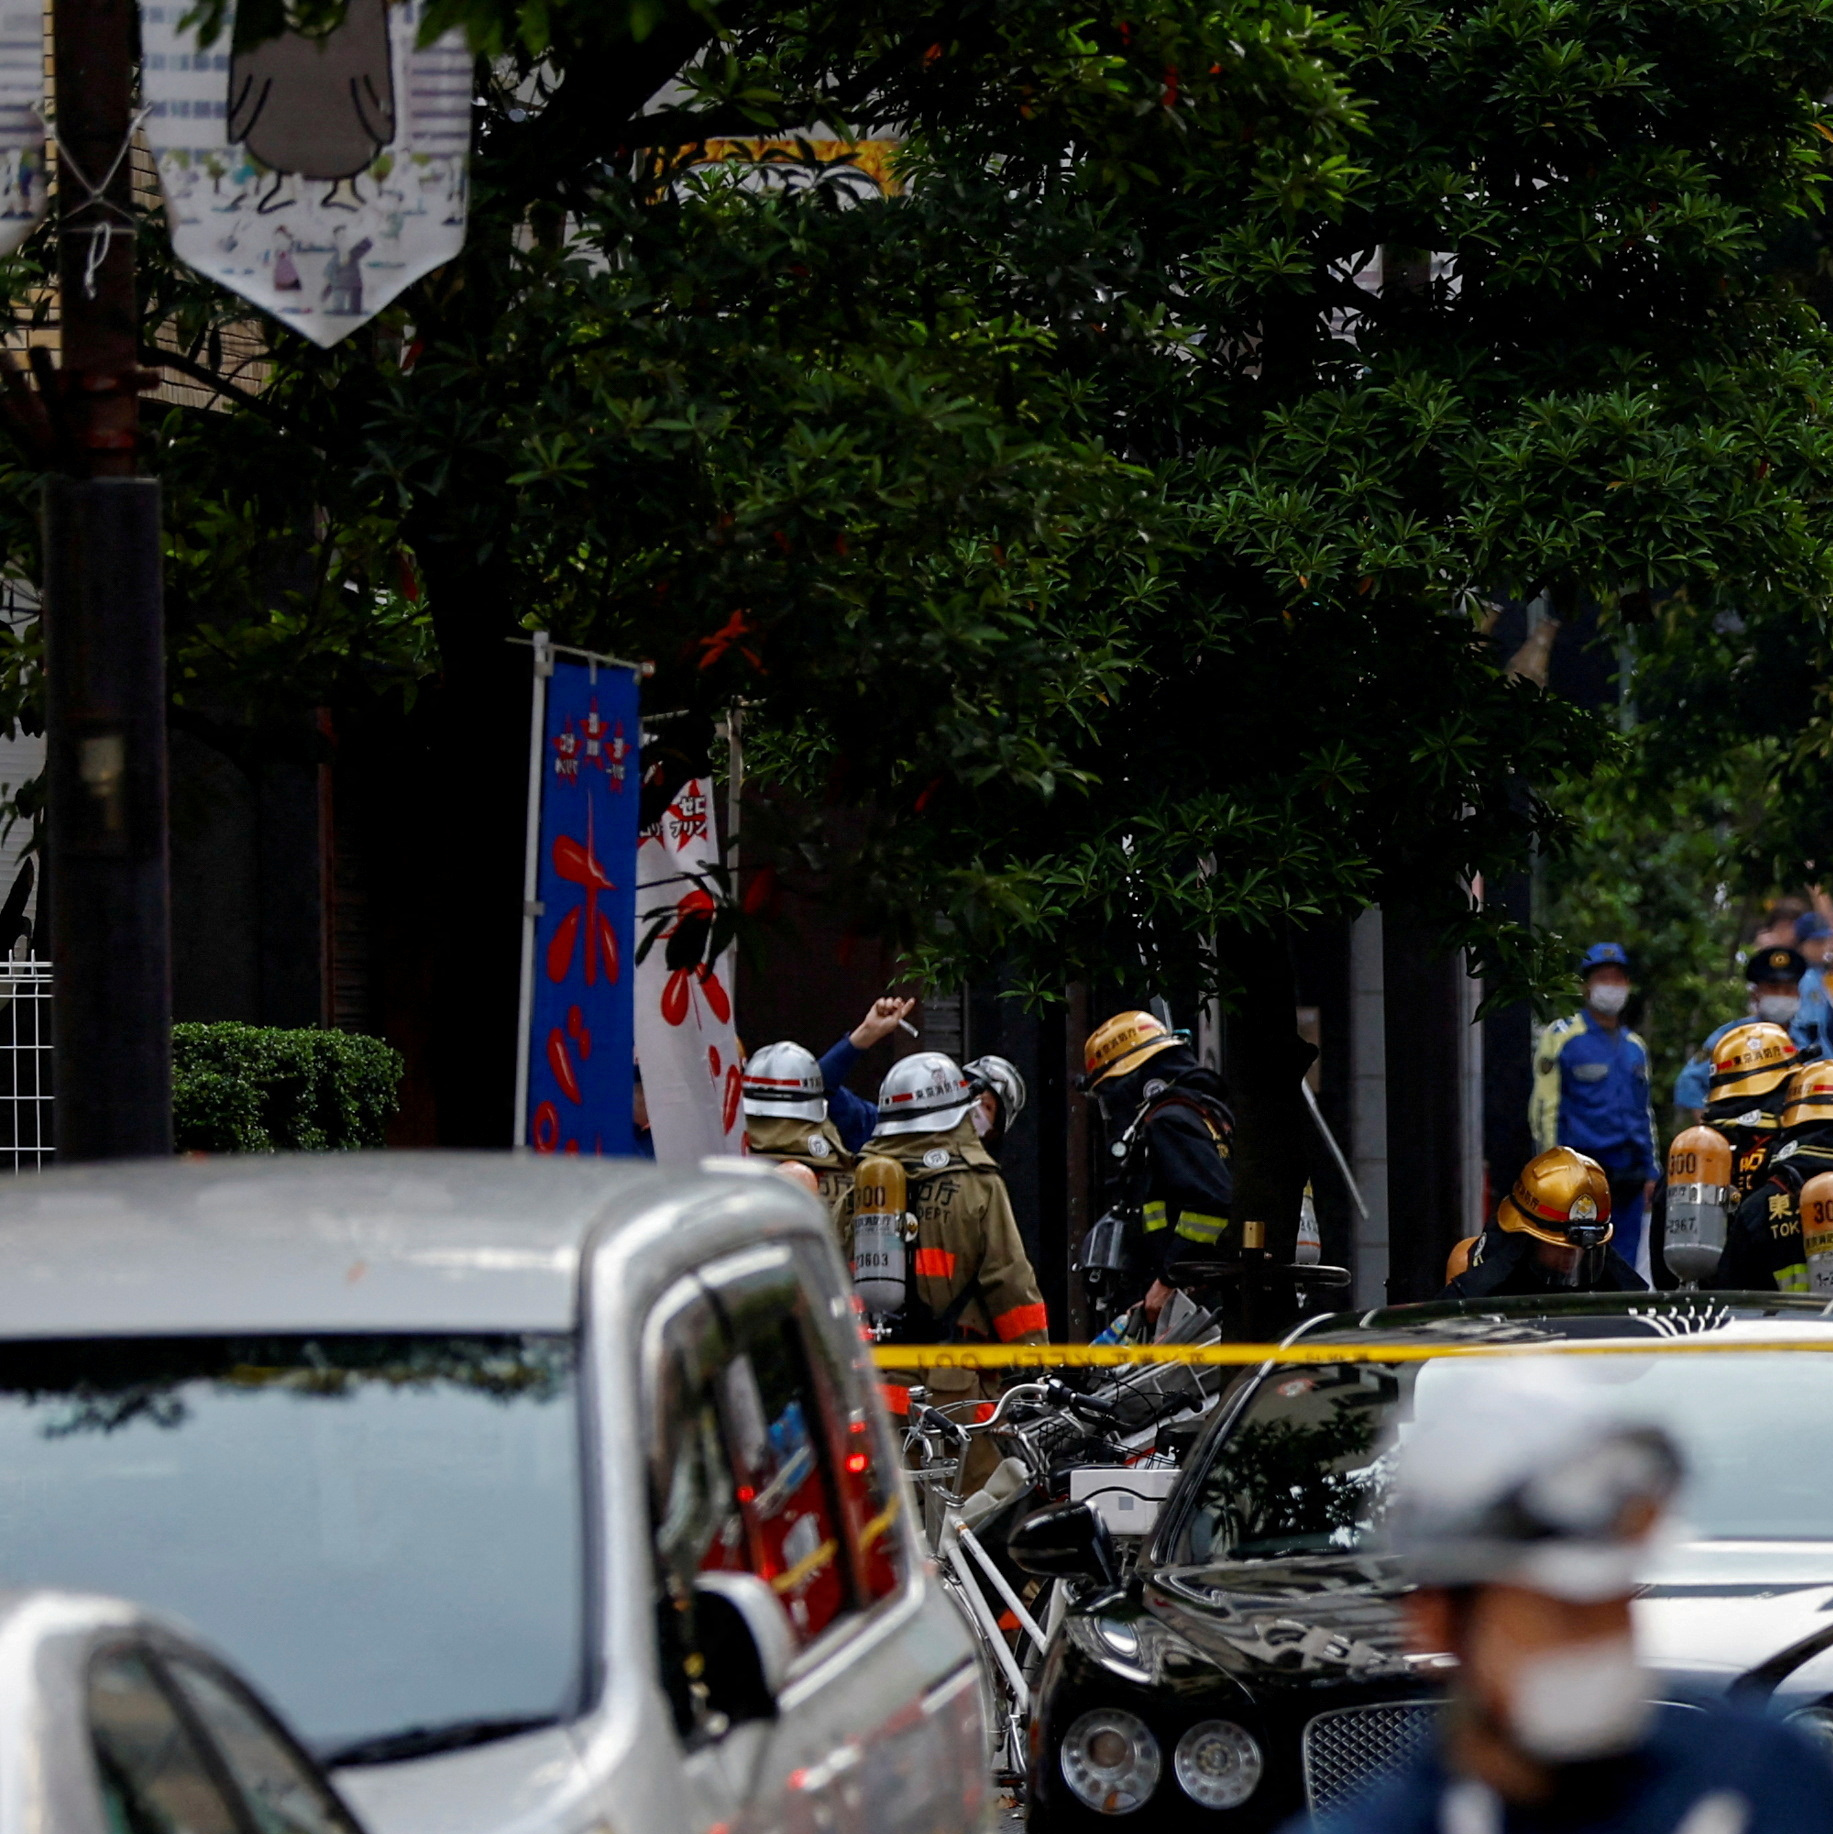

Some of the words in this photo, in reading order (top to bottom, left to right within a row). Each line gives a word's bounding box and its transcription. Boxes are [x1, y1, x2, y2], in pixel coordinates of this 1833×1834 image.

[1733, 1046, 1781, 1065] 東京消防庁
[915, 1080, 960, 1100] 東京消防庁
